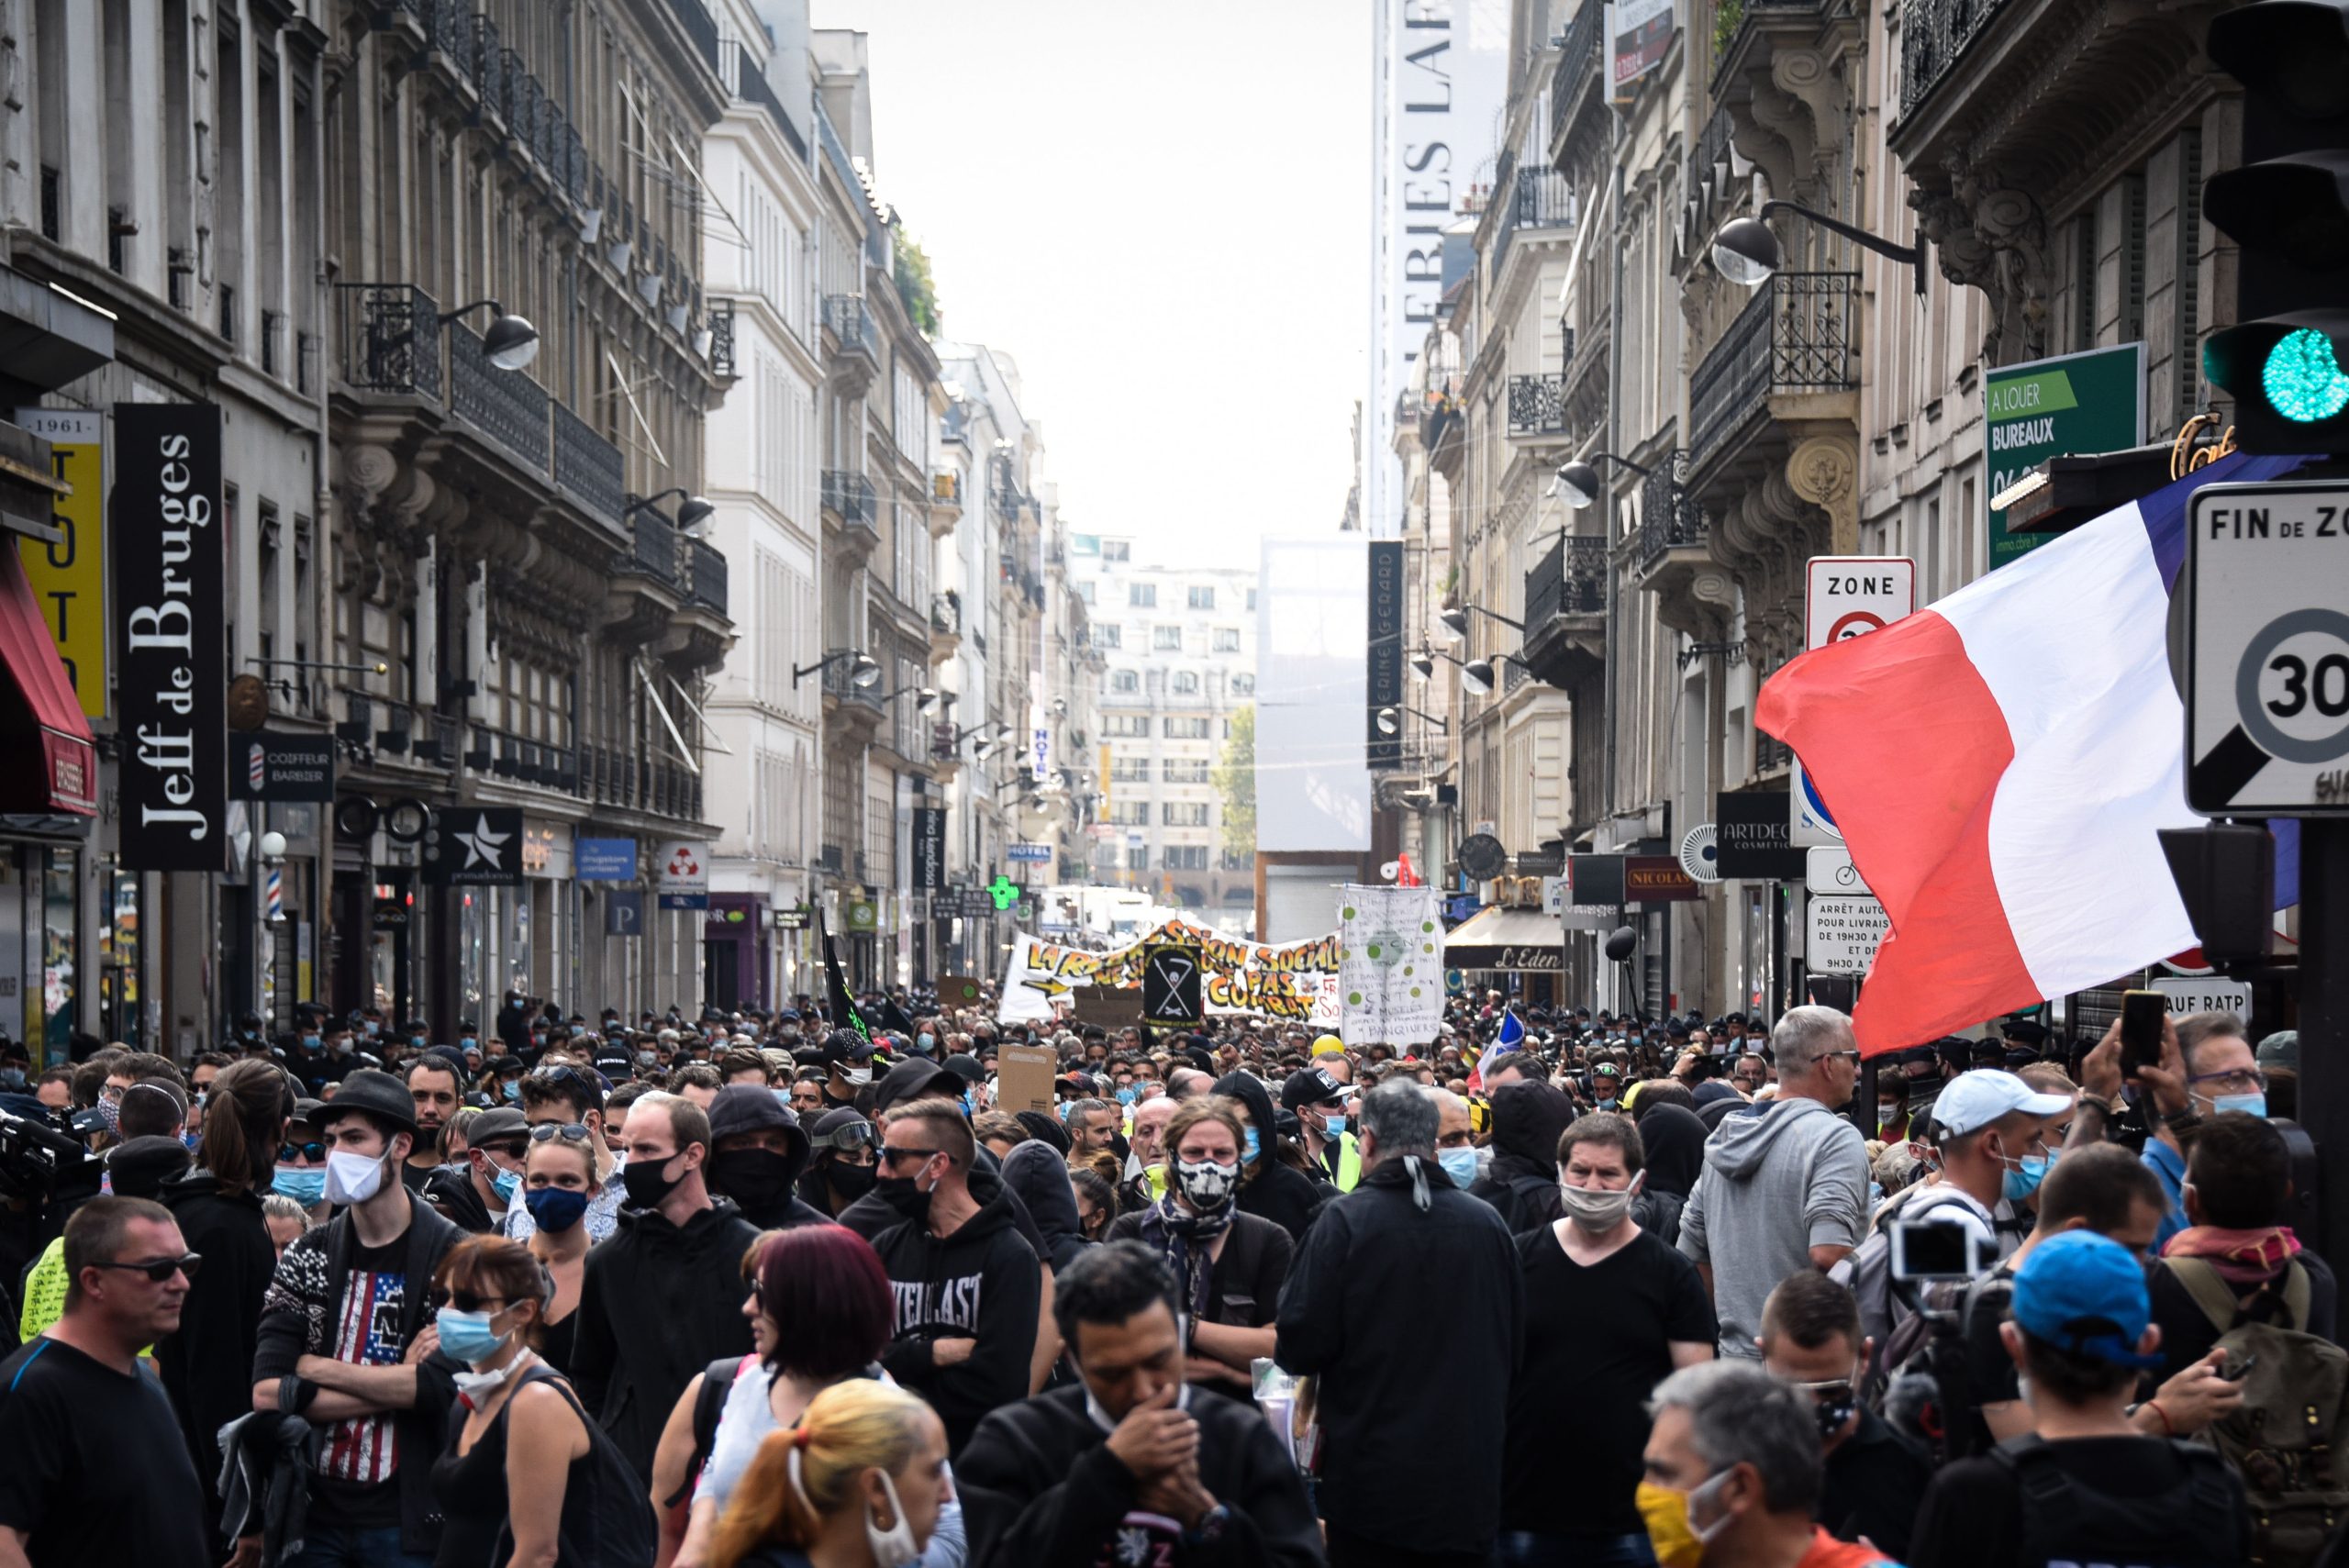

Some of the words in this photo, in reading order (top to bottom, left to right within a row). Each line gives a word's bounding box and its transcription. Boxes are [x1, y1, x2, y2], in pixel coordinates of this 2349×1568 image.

[1991, 390, 2002, 412] A
[2004, 383, 2041, 410] LOUER
[36, 419, 83, 433] 1961
[1992, 417, 2054, 450] BUREAUX
[2210, 508, 2269, 539] FIN
[2280, 522, 2304, 539] DE
[128, 434, 211, 659] Bruges
[1828, 577, 1894, 595] ZONE
[156, 666, 194, 715] de
[2266, 653, 2349, 717] 30
[267, 752, 330, 765] COIFFEUR
[137, 721, 208, 841] Jeff
[272, 771, 324, 782] BARBIER
[1723, 822, 1790, 840] ARTDEC
[1734, 841, 1790, 850] COSMETIC
[1631, 871, 1689, 884] NICOLAS
[1820, 903, 1854, 914] ARRÊT
[1858, 905, 1887, 914] AUTO
[616, 906, 634, 931] P
[1817, 919, 1844, 928] POUR
[1849, 919, 1889, 928] LIVRAIS
[1820, 932, 1832, 940] DE
[1837, 932, 1867, 941] 19H30
[1872, 932, 1878, 941] A
[1027, 942, 1060, 971] LA
[1849, 946, 1859, 955] ET
[1827, 960, 1853, 968] 9H30
[1857, 959, 1864, 968] A
[1245, 970, 1297, 997] PAS
[2165, 996, 2196, 1012] AUF
[2204, 995, 2243, 1011] RATP
